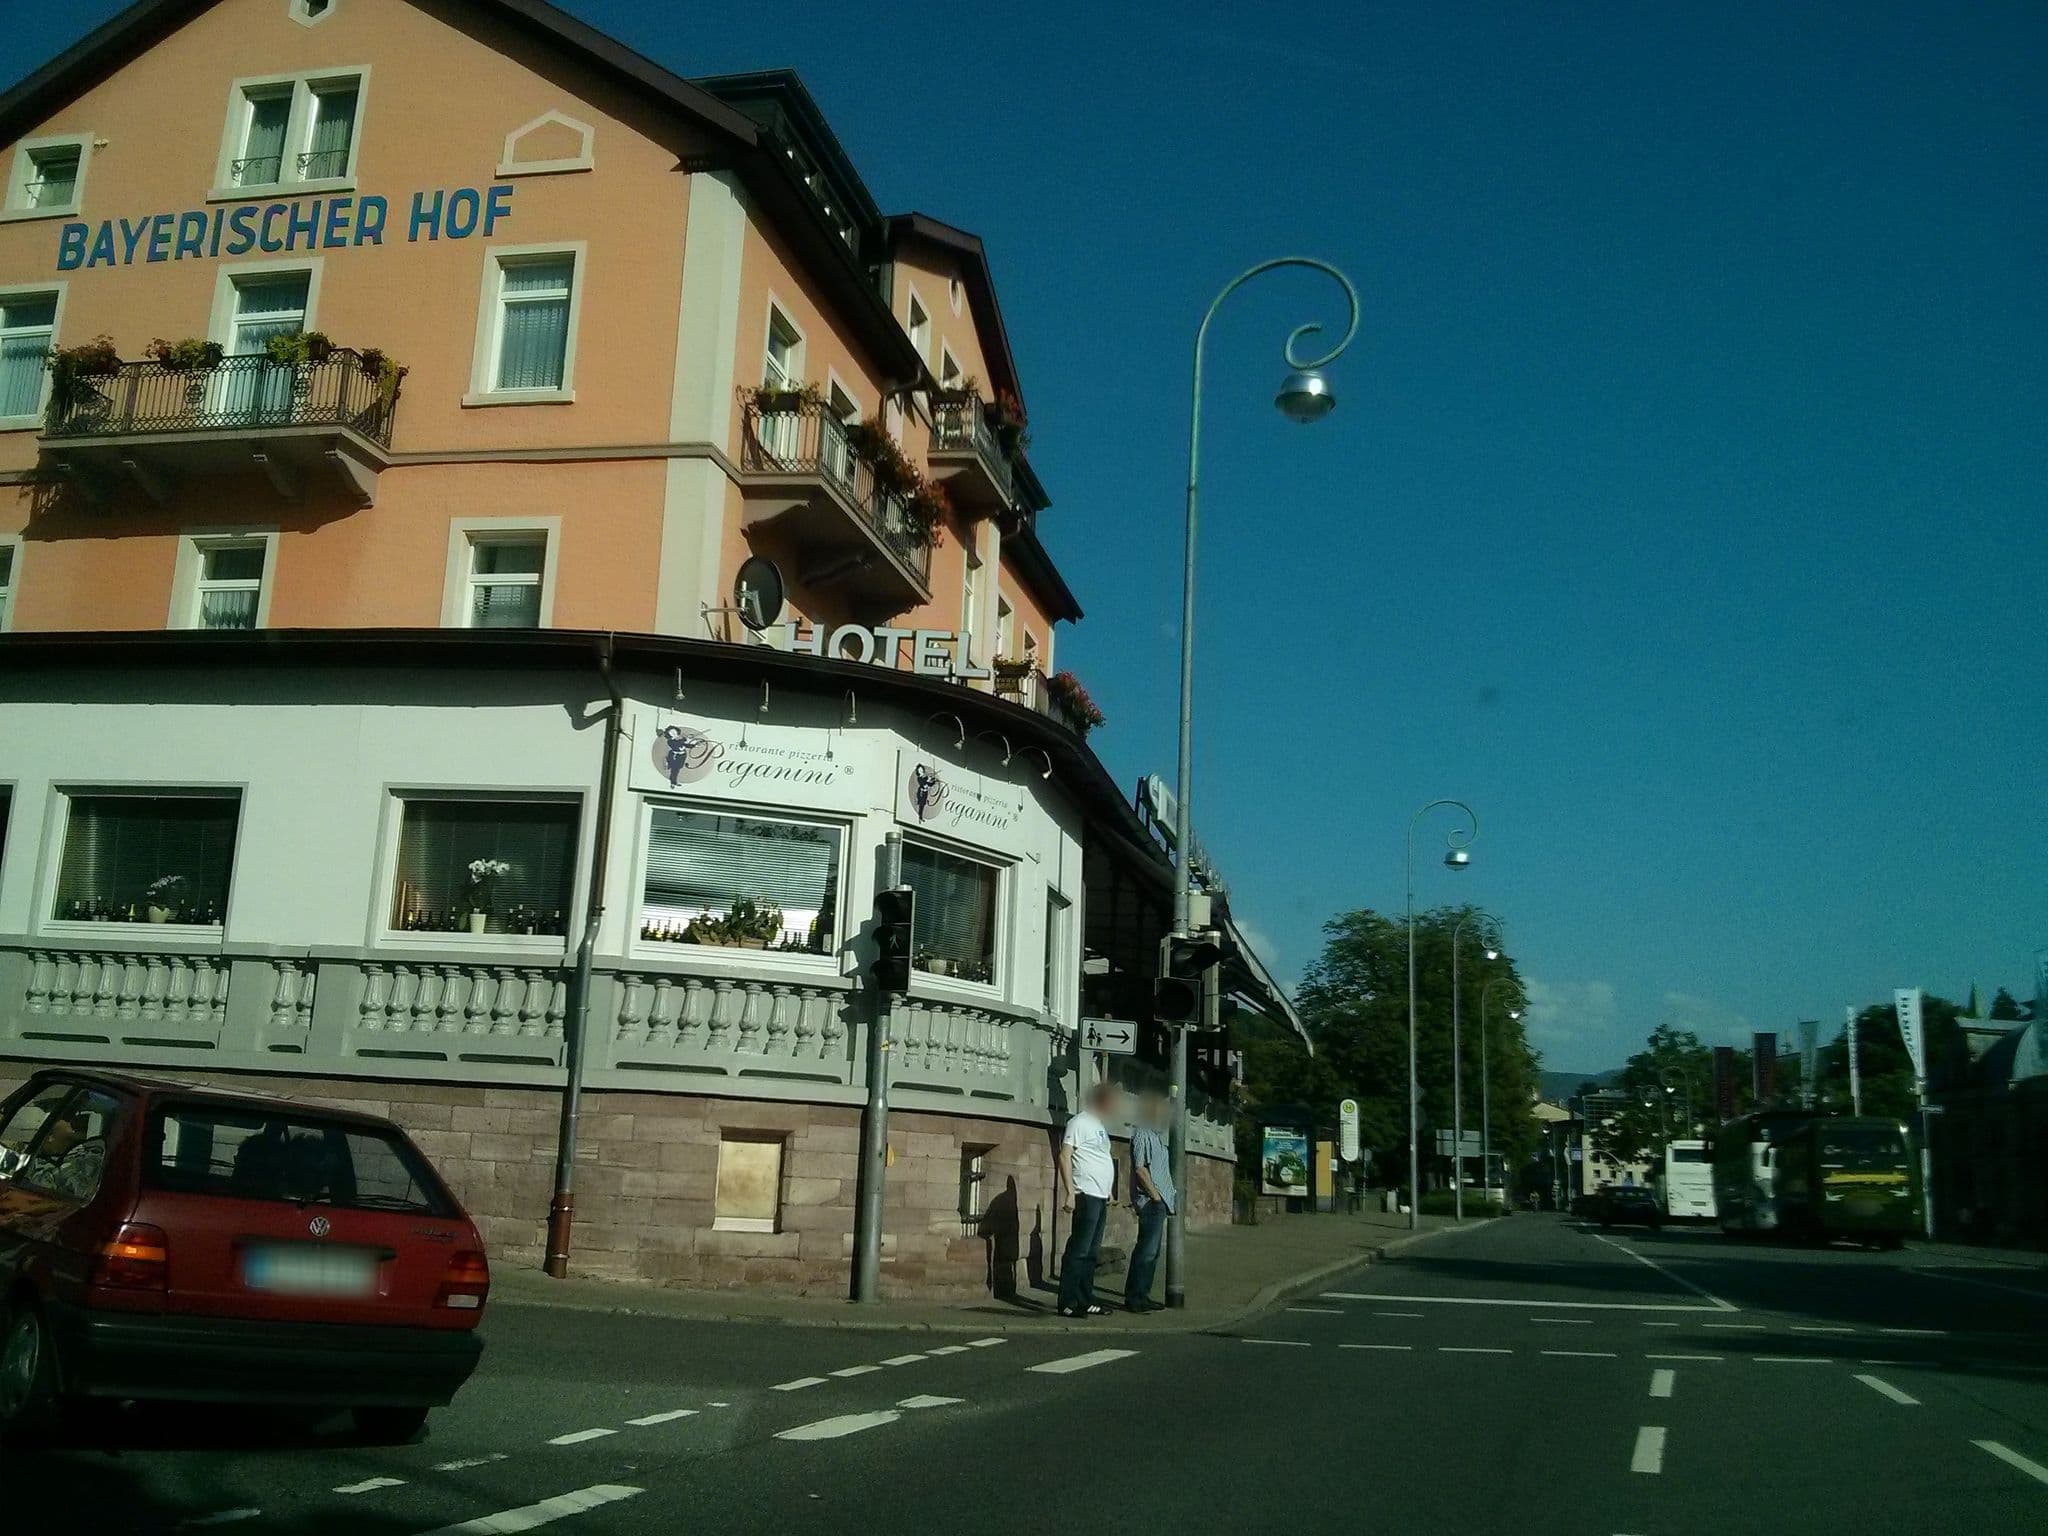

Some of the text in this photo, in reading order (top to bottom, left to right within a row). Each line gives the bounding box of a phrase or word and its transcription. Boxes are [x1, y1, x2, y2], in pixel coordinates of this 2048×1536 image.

[57, 185, 514, 271] BAYERISCHER HOF
[784, 623, 990, 679] HOTEL
[685, 738, 838, 789] Paganini
[927, 779, 1010, 830] Paganini
